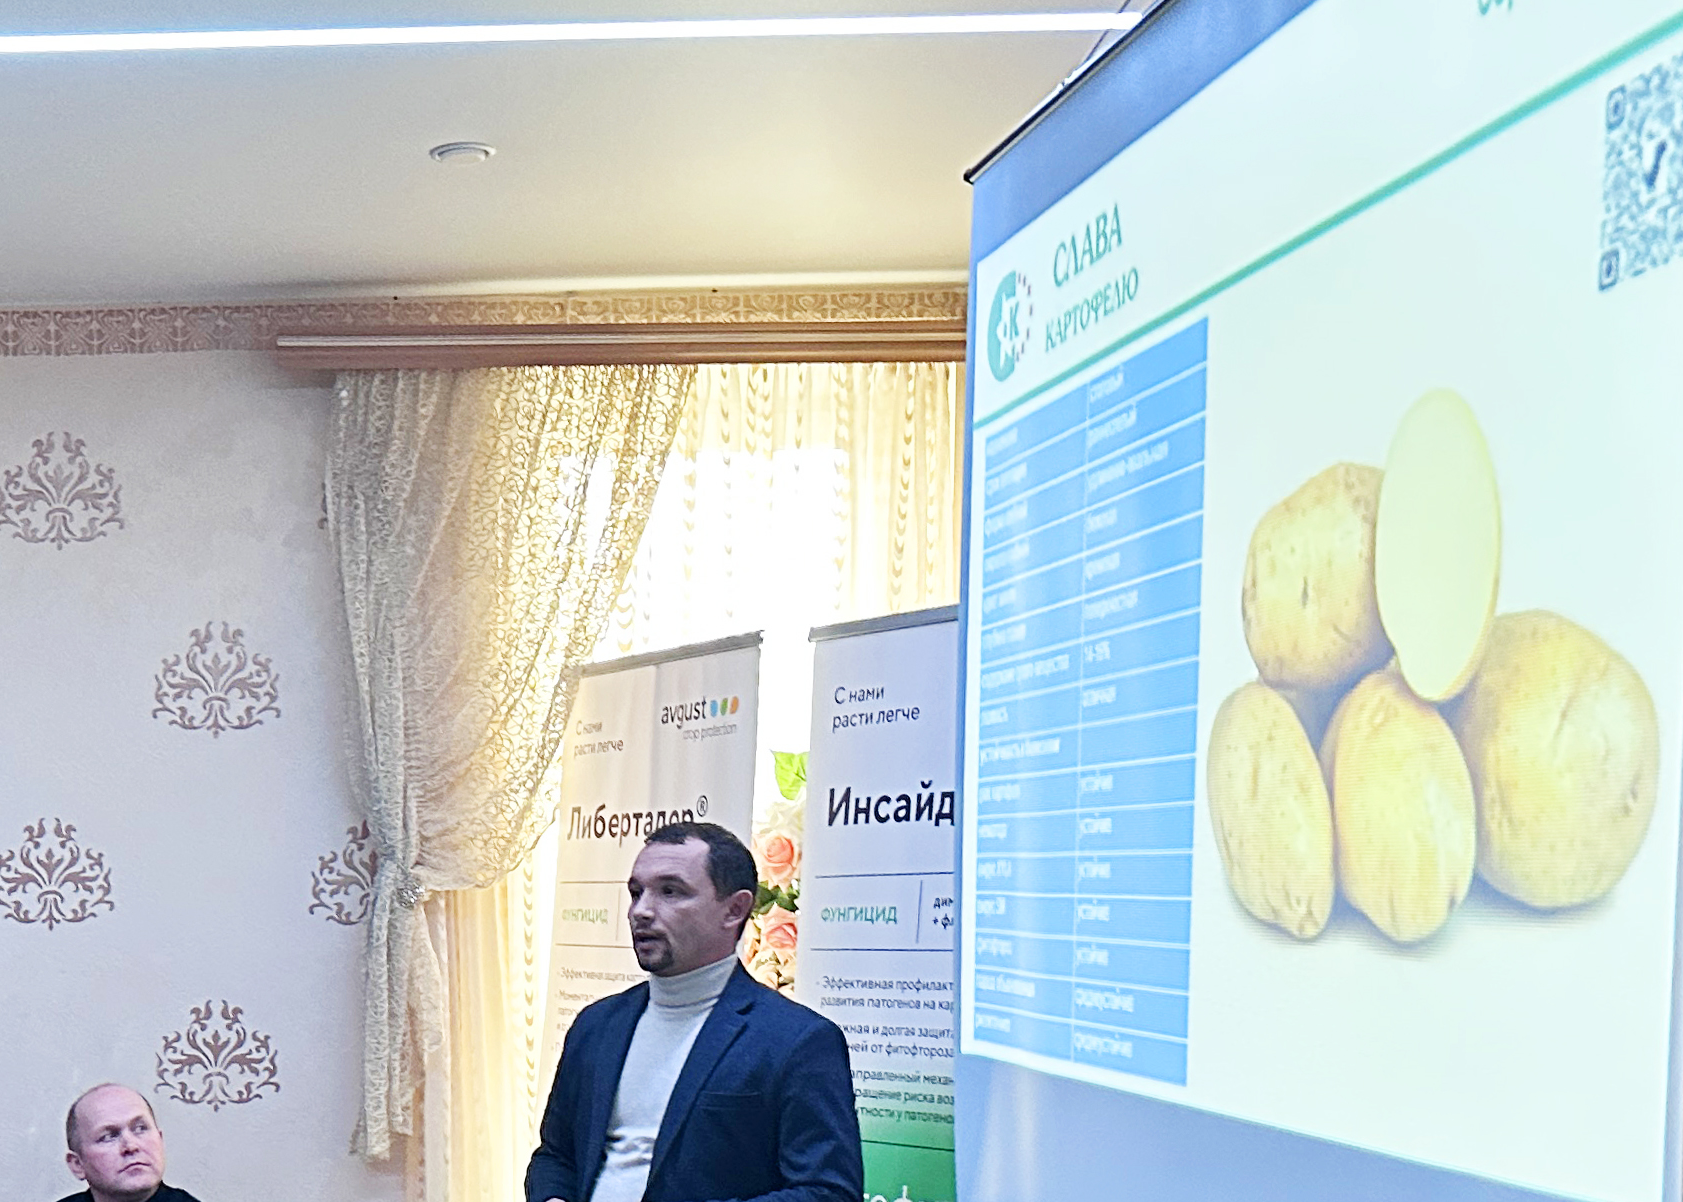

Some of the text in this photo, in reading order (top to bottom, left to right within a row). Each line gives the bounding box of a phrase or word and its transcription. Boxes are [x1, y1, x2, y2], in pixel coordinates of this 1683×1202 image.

[1053, 203, 1122, 288] СЛАВА
[1045, 266, 1139, 353] КАРТОФЕЛЮ
[834, 686, 885, 705] С нами
[661, 696, 707, 729] avgust
[832, 706, 921, 734] расти легче
[575, 719, 583, 736] С
[597, 739, 624, 754] легче
[827, 780, 955, 827] Инсайд
[820, 905, 898, 925] ФУНГИЦИД
[822, 975, 954, 993] Эффективная профилакт
[820, 996, 865, 1009] развития
[867, 997, 921, 1010] патогенов
[923, 1000, 936, 1011] на
[838, 1023, 870, 1035] жная
[880, 1025, 916, 1037] долгая
[870, 1043, 884, 1054] от
[904, 1091, 935, 1104] риска
